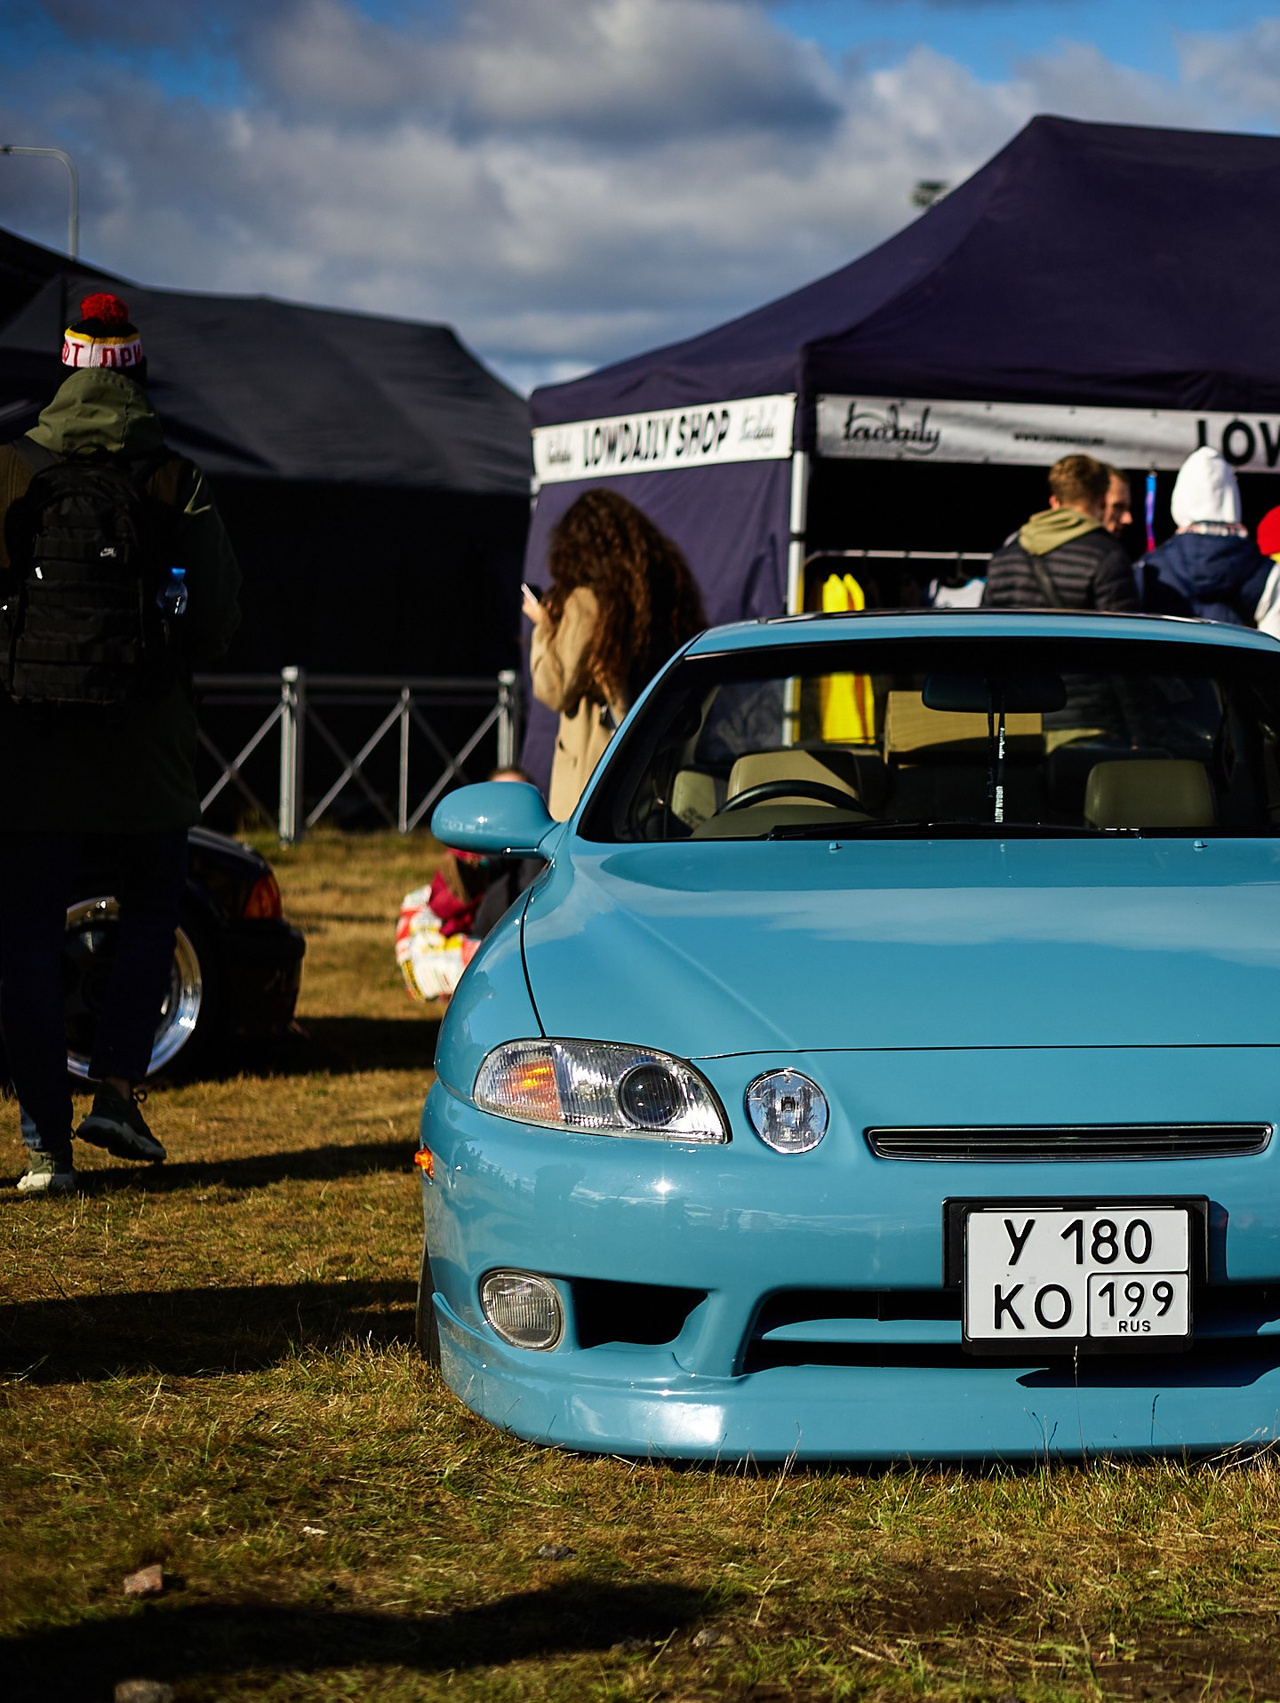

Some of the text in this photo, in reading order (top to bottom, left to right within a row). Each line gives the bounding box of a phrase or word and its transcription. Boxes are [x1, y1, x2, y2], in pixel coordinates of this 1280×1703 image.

[584, 417, 674, 467] LOWDAILY
[676, 409, 730, 457] SHOP
[1060, 1218, 1152, 1265] 180
[1098, 1281, 1174, 1317] 199
[1118, 1320, 1152, 1333] RUS
